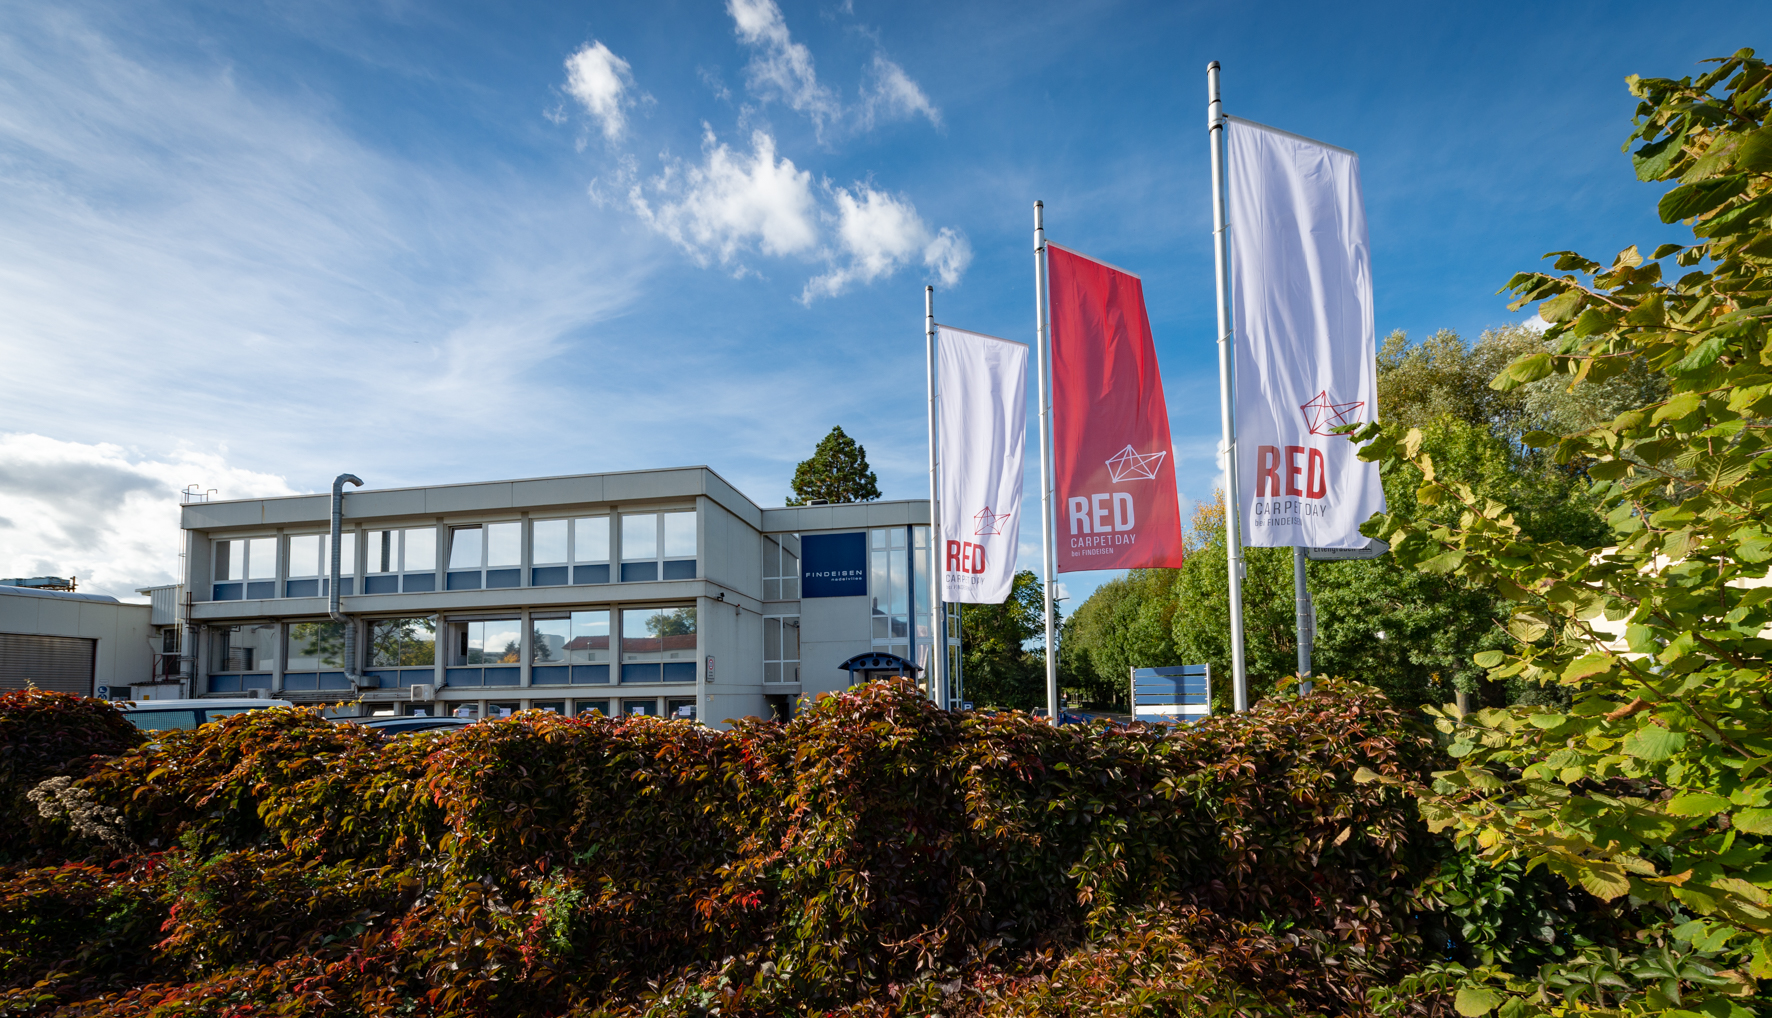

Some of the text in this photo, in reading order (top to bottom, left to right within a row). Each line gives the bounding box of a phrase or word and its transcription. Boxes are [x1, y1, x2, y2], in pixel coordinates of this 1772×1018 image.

[1256, 445, 1327, 499] RED
[1068, 492, 1135, 535] RED
[1255, 500, 1327, 517] CARPET DAY
[1070, 534, 1136, 548] CARPET DAY
[946, 540, 986, 574] RED
[1082, 547, 1114, 556] FINDEISEN
[805, 570, 863, 578] FINDEISEN
